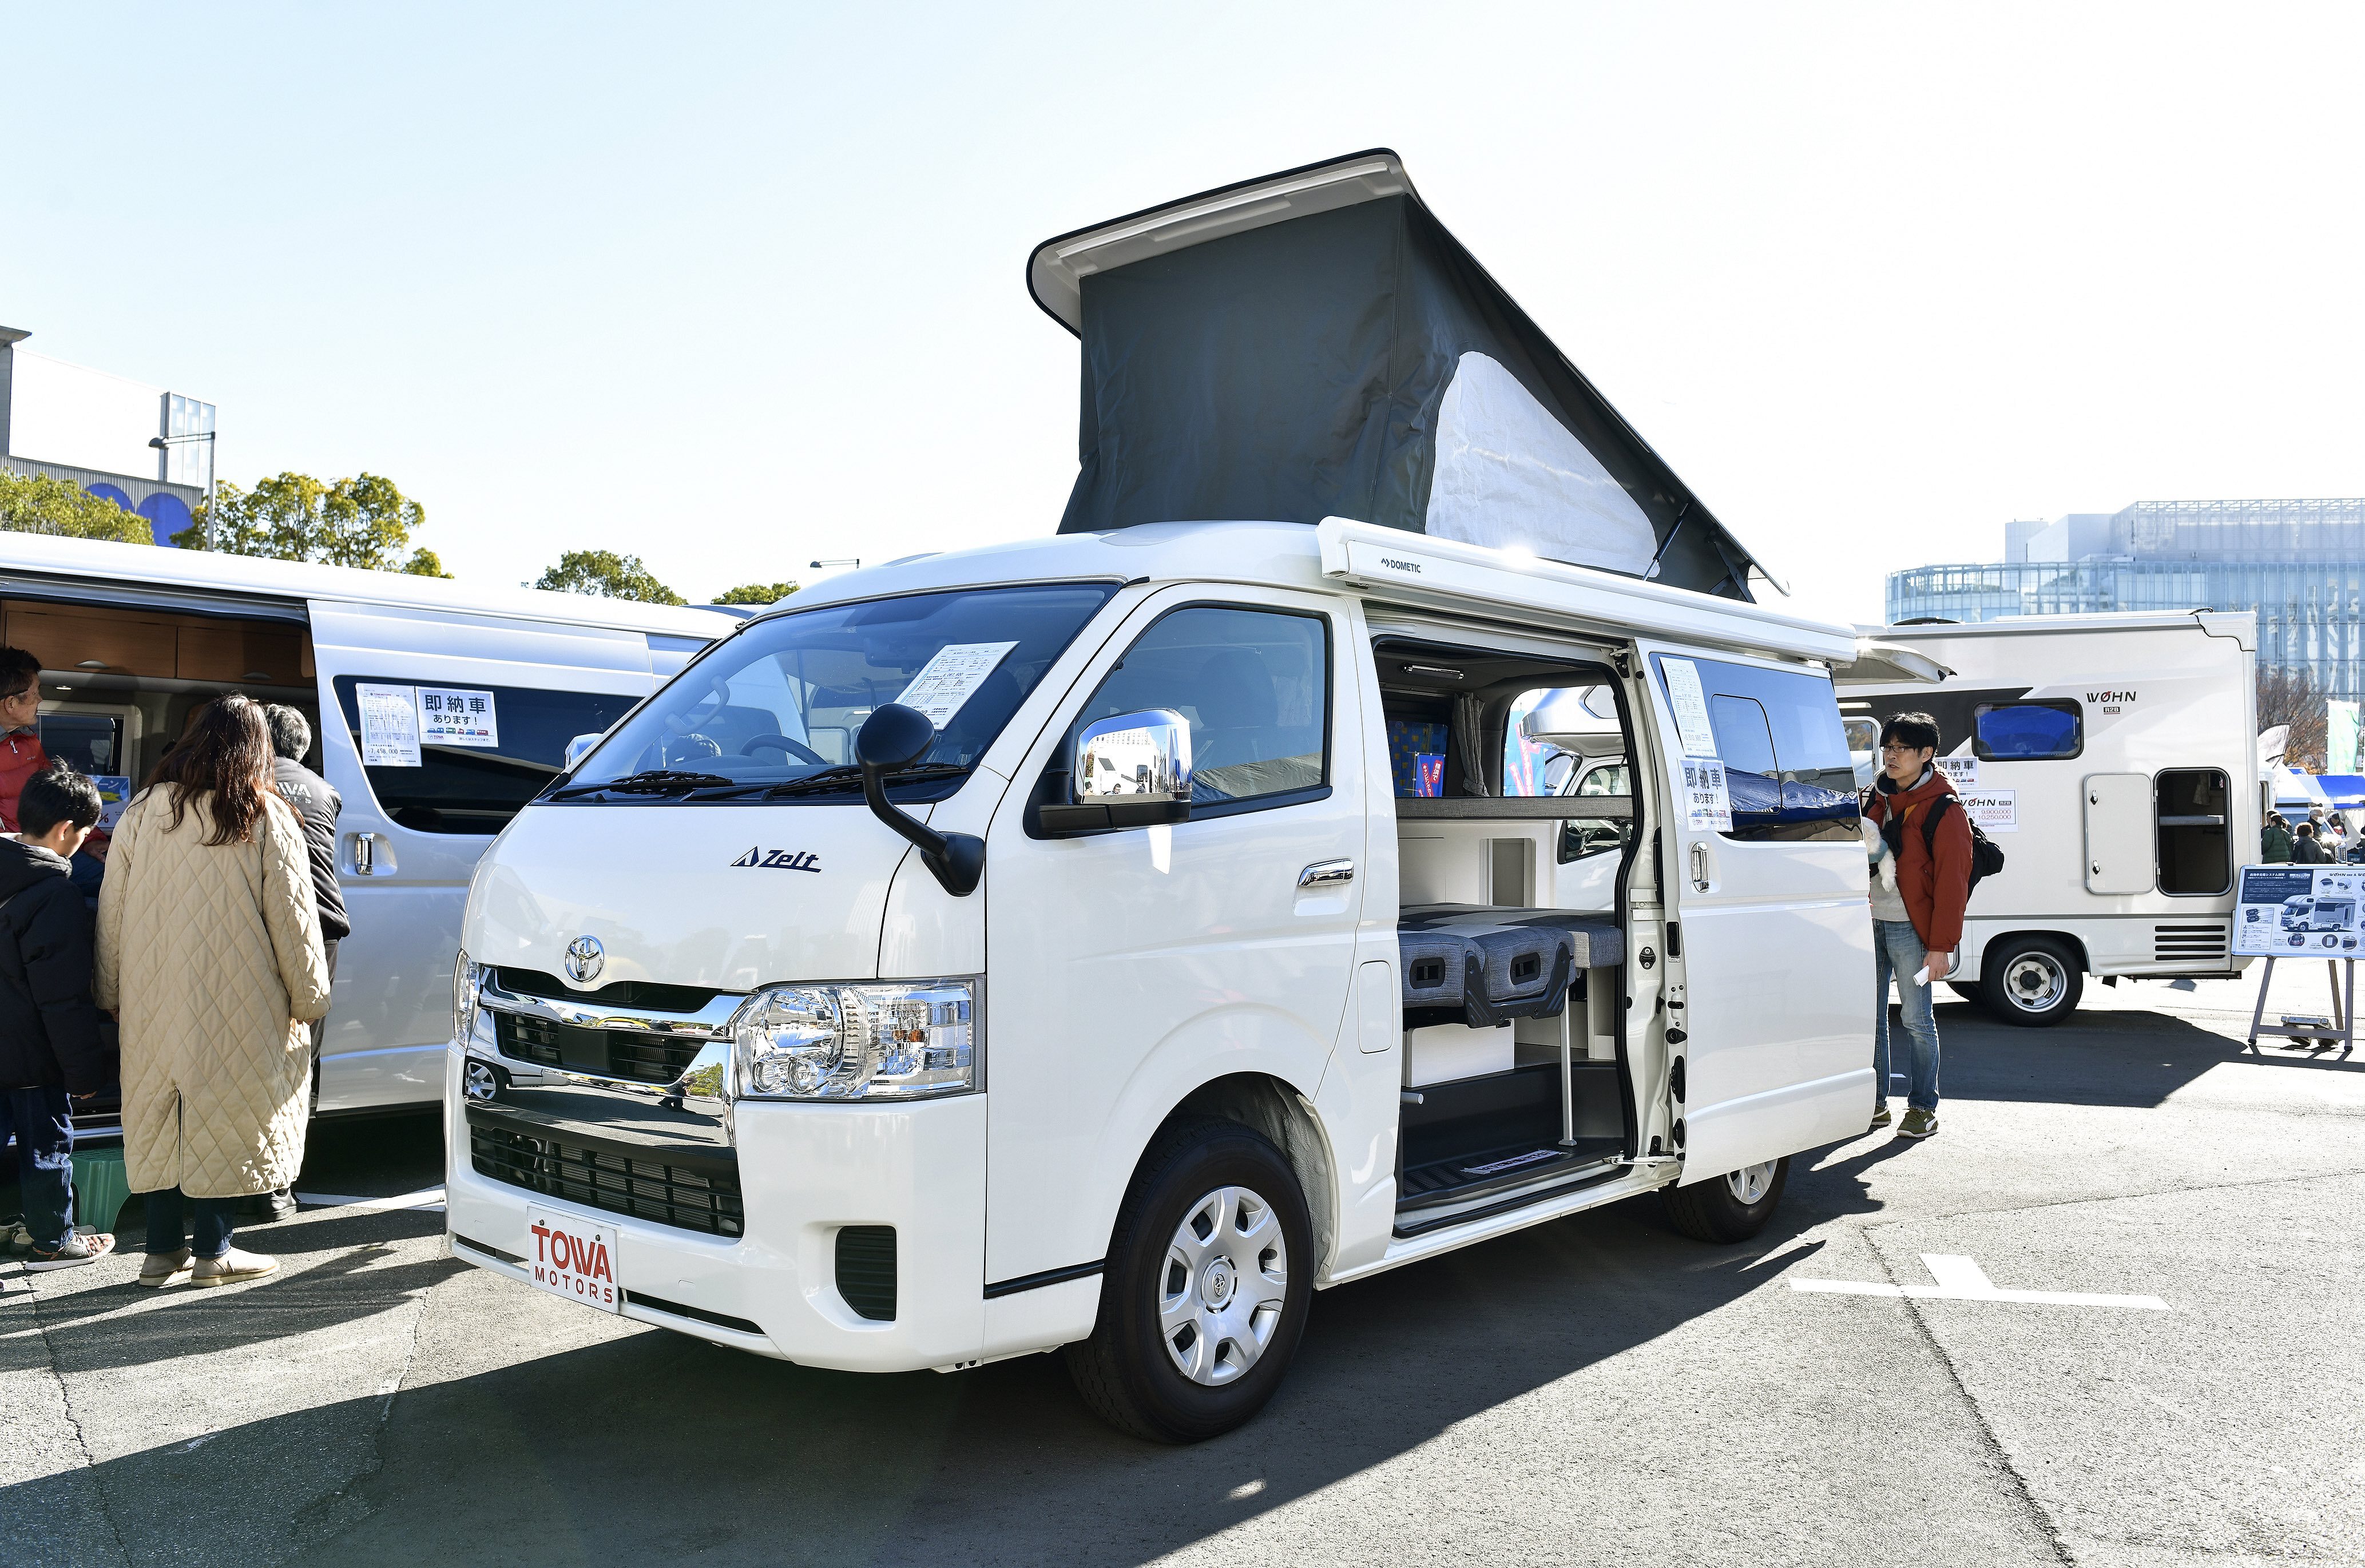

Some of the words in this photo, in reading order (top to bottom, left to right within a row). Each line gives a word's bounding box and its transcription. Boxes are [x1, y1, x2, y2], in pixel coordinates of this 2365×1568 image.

[1390, 559, 1421, 573] DOMETIC
[425, 694, 486, 714] 即納車
[433, 714, 478, 725] あります！
[1433, 763, 1441, 781] 横浜で
[1685, 767, 1722, 790] 即納車
[275, 781, 312, 797] WA
[1693, 792, 1719, 804] あります！
[757, 850, 822, 873] Zelt
[531, 1224, 613, 1284] TOWA
[535, 1265, 613, 1304] MOTORS
